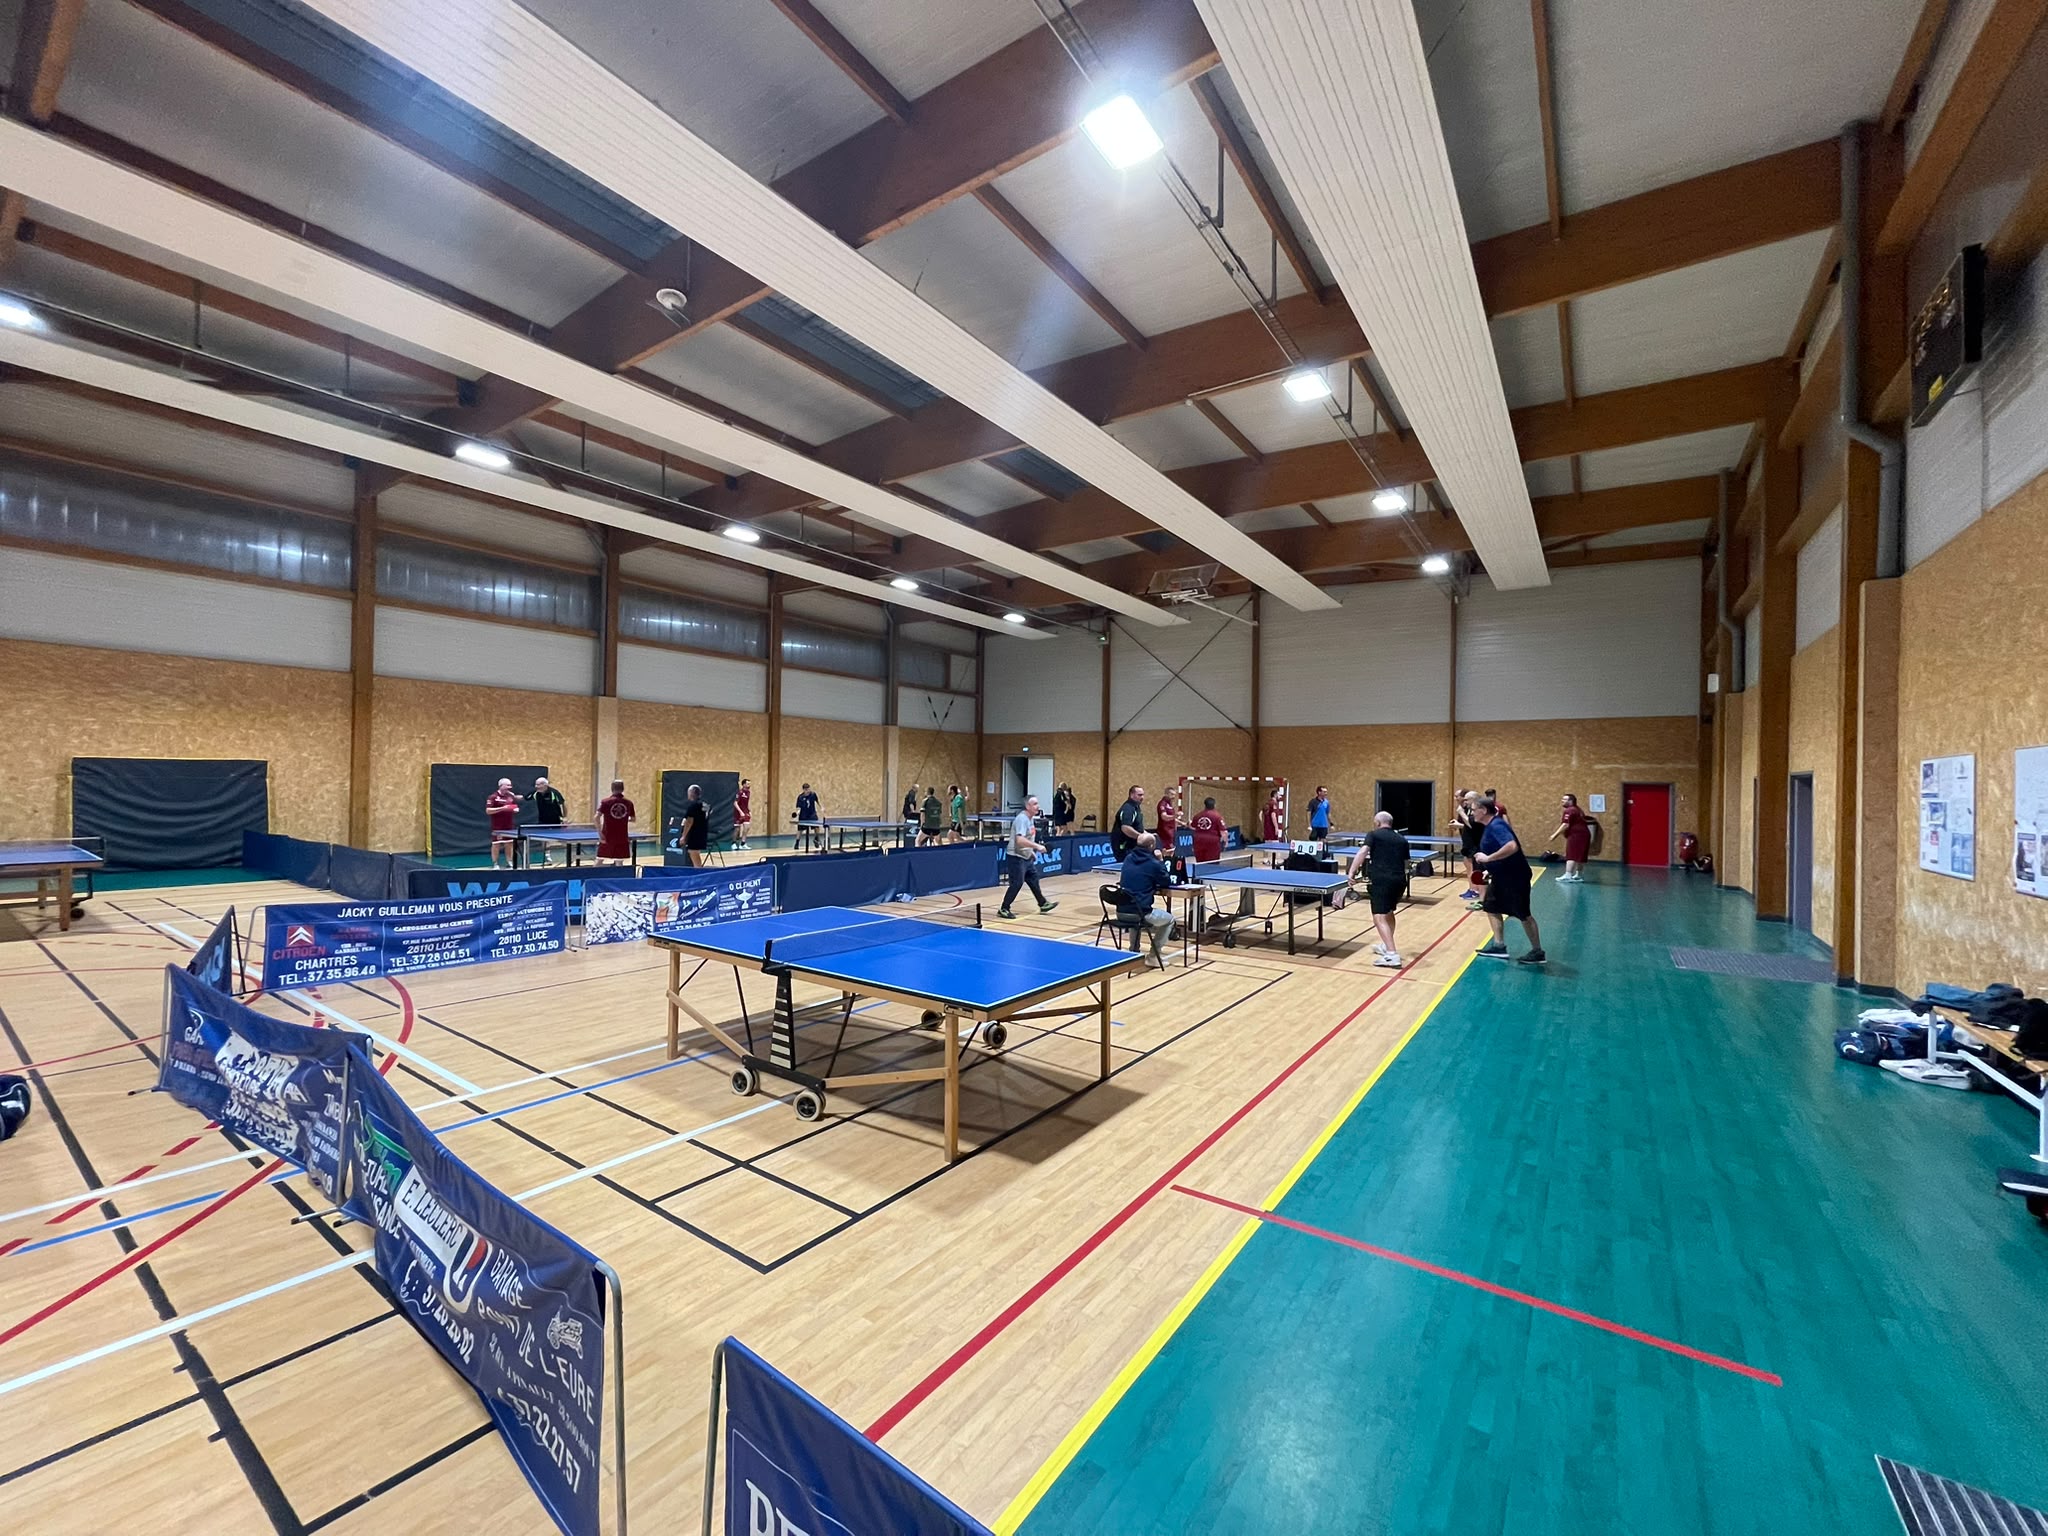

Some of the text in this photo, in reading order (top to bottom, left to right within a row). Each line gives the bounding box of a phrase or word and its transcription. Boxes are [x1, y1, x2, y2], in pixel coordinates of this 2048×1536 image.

[337, 895, 513, 918] JACKY GUILLEMAN VOUS PRESENTE
[406, 940, 460, 954] 28110 LUCE
[498, 930, 548, 946] 28110 LUCE
[295, 956, 358, 970] CHARTRES
[490, 1248, 532, 1309] GARAGE
[518, 1322, 534, 1368] DE
[539, 1348, 595, 1425] L'EURE
